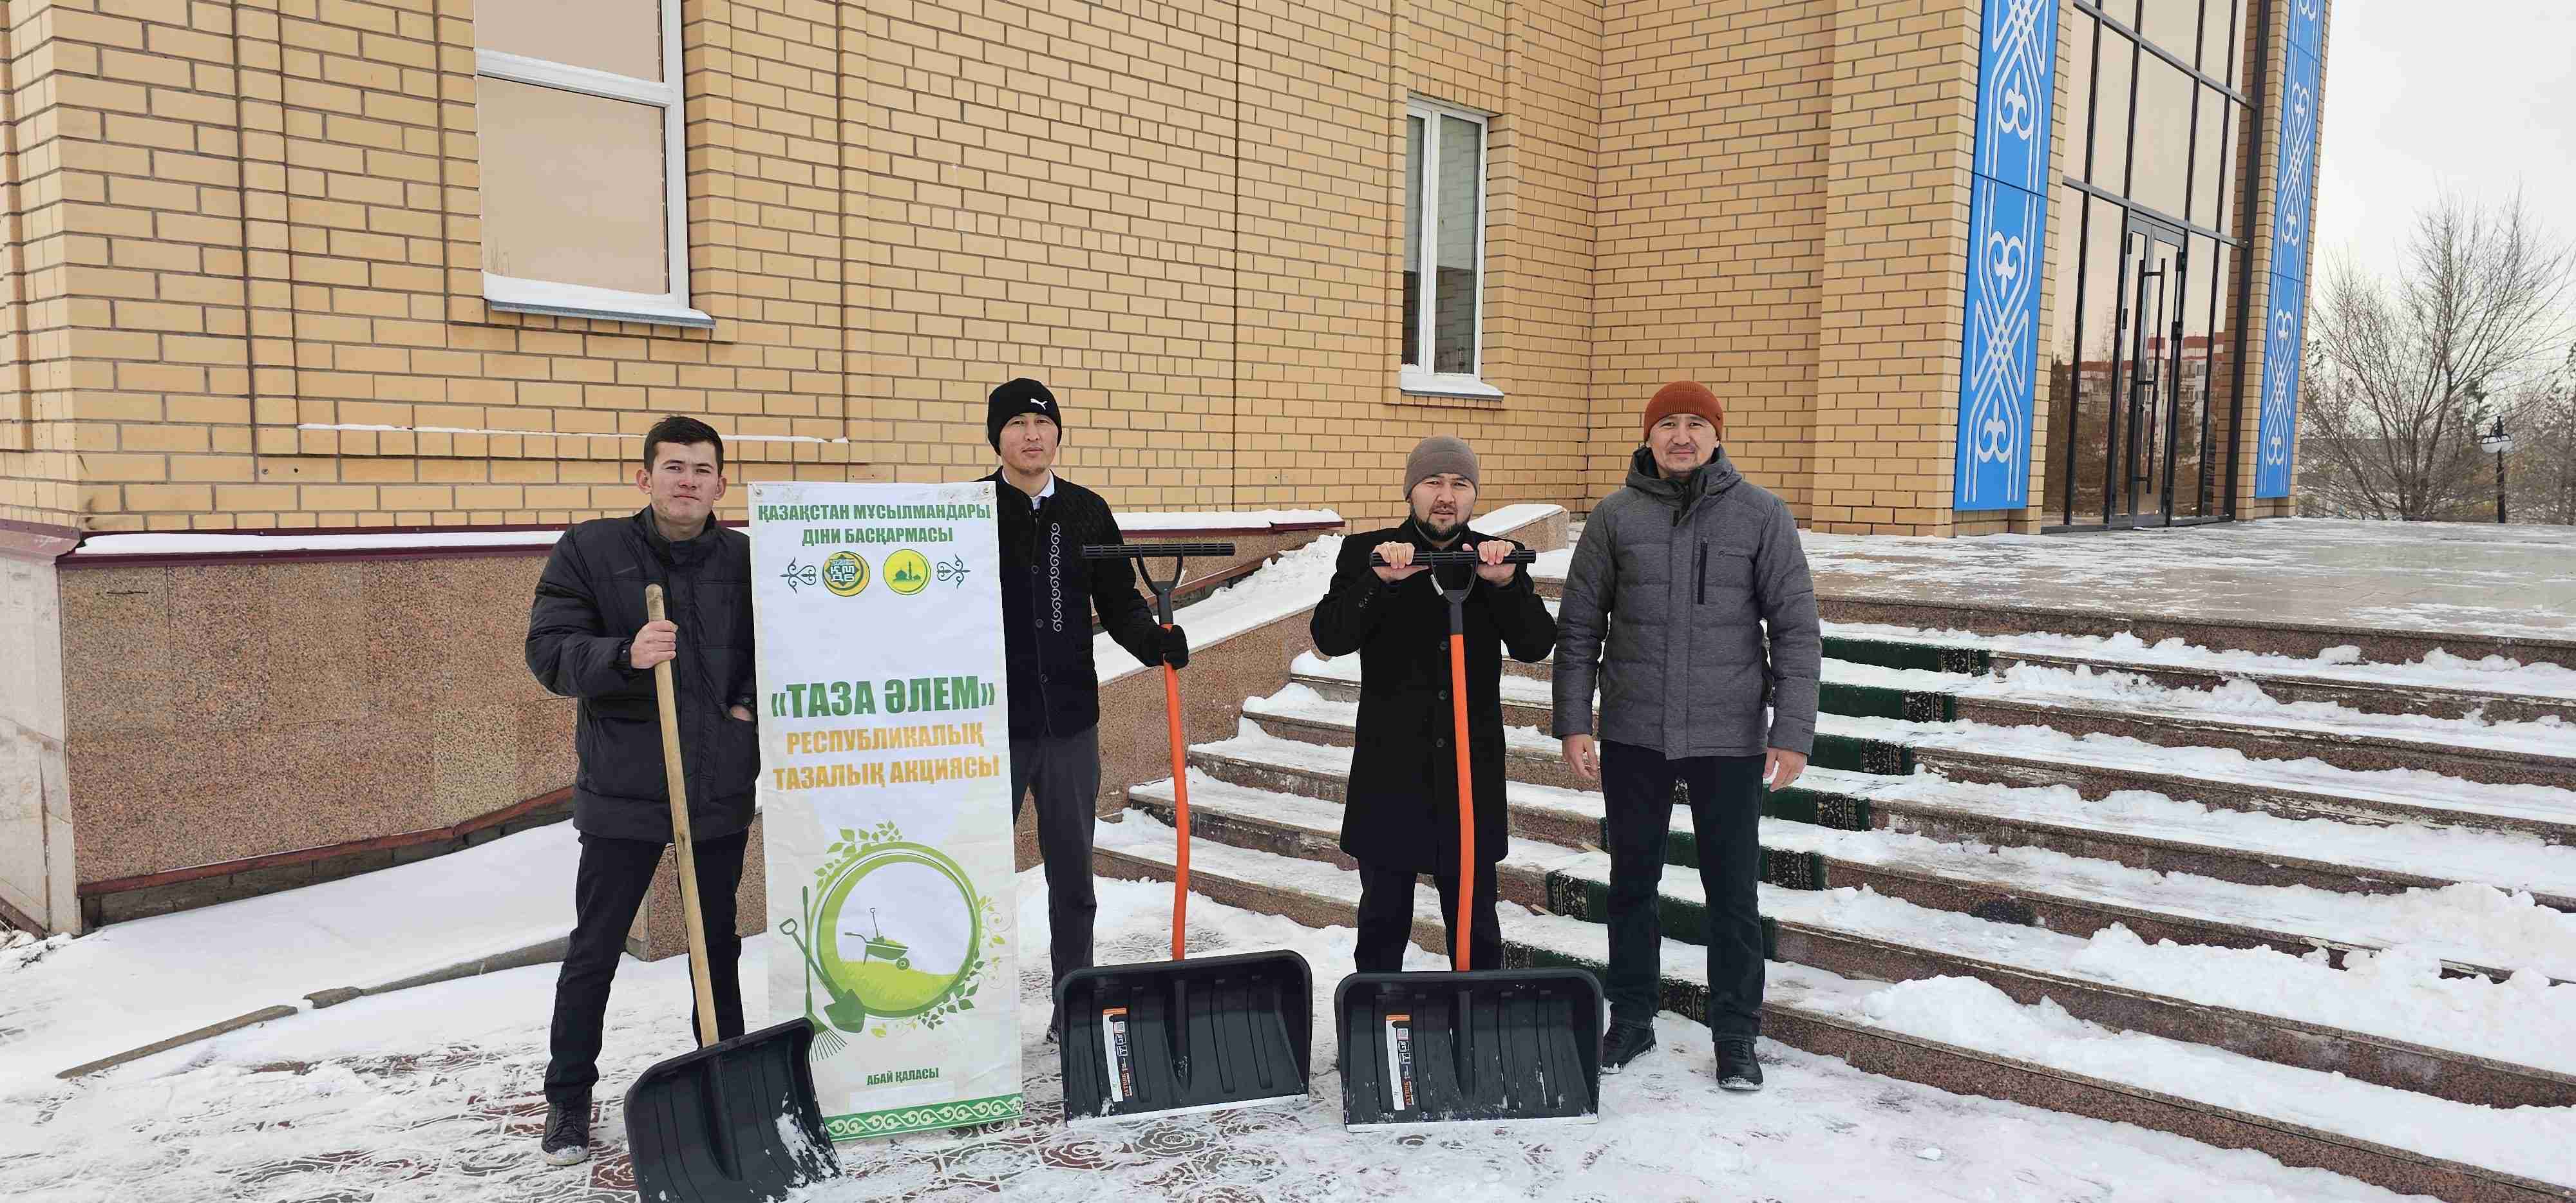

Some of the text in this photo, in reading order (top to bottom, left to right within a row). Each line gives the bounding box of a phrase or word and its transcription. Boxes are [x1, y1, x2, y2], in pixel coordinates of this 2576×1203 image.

[758, 504, 990, 523] ҚАЗАҚСТАН МҰСЫЛМАНДАРЫ
[802, 527, 953, 546] ДІНИ БАСҚАРМАСЫ
[772, 676, 995, 718] «ТАЗА ӘЛЕМ»
[786, 721, 985, 755] РЕСПУБЛИКАЛЫҚ
[772, 755, 1000, 791] ТАЗАЛЫҚ АКЦИЯСЫ
[866, 1067, 940, 1086] АБАЙ ҚАЛАСЫ
